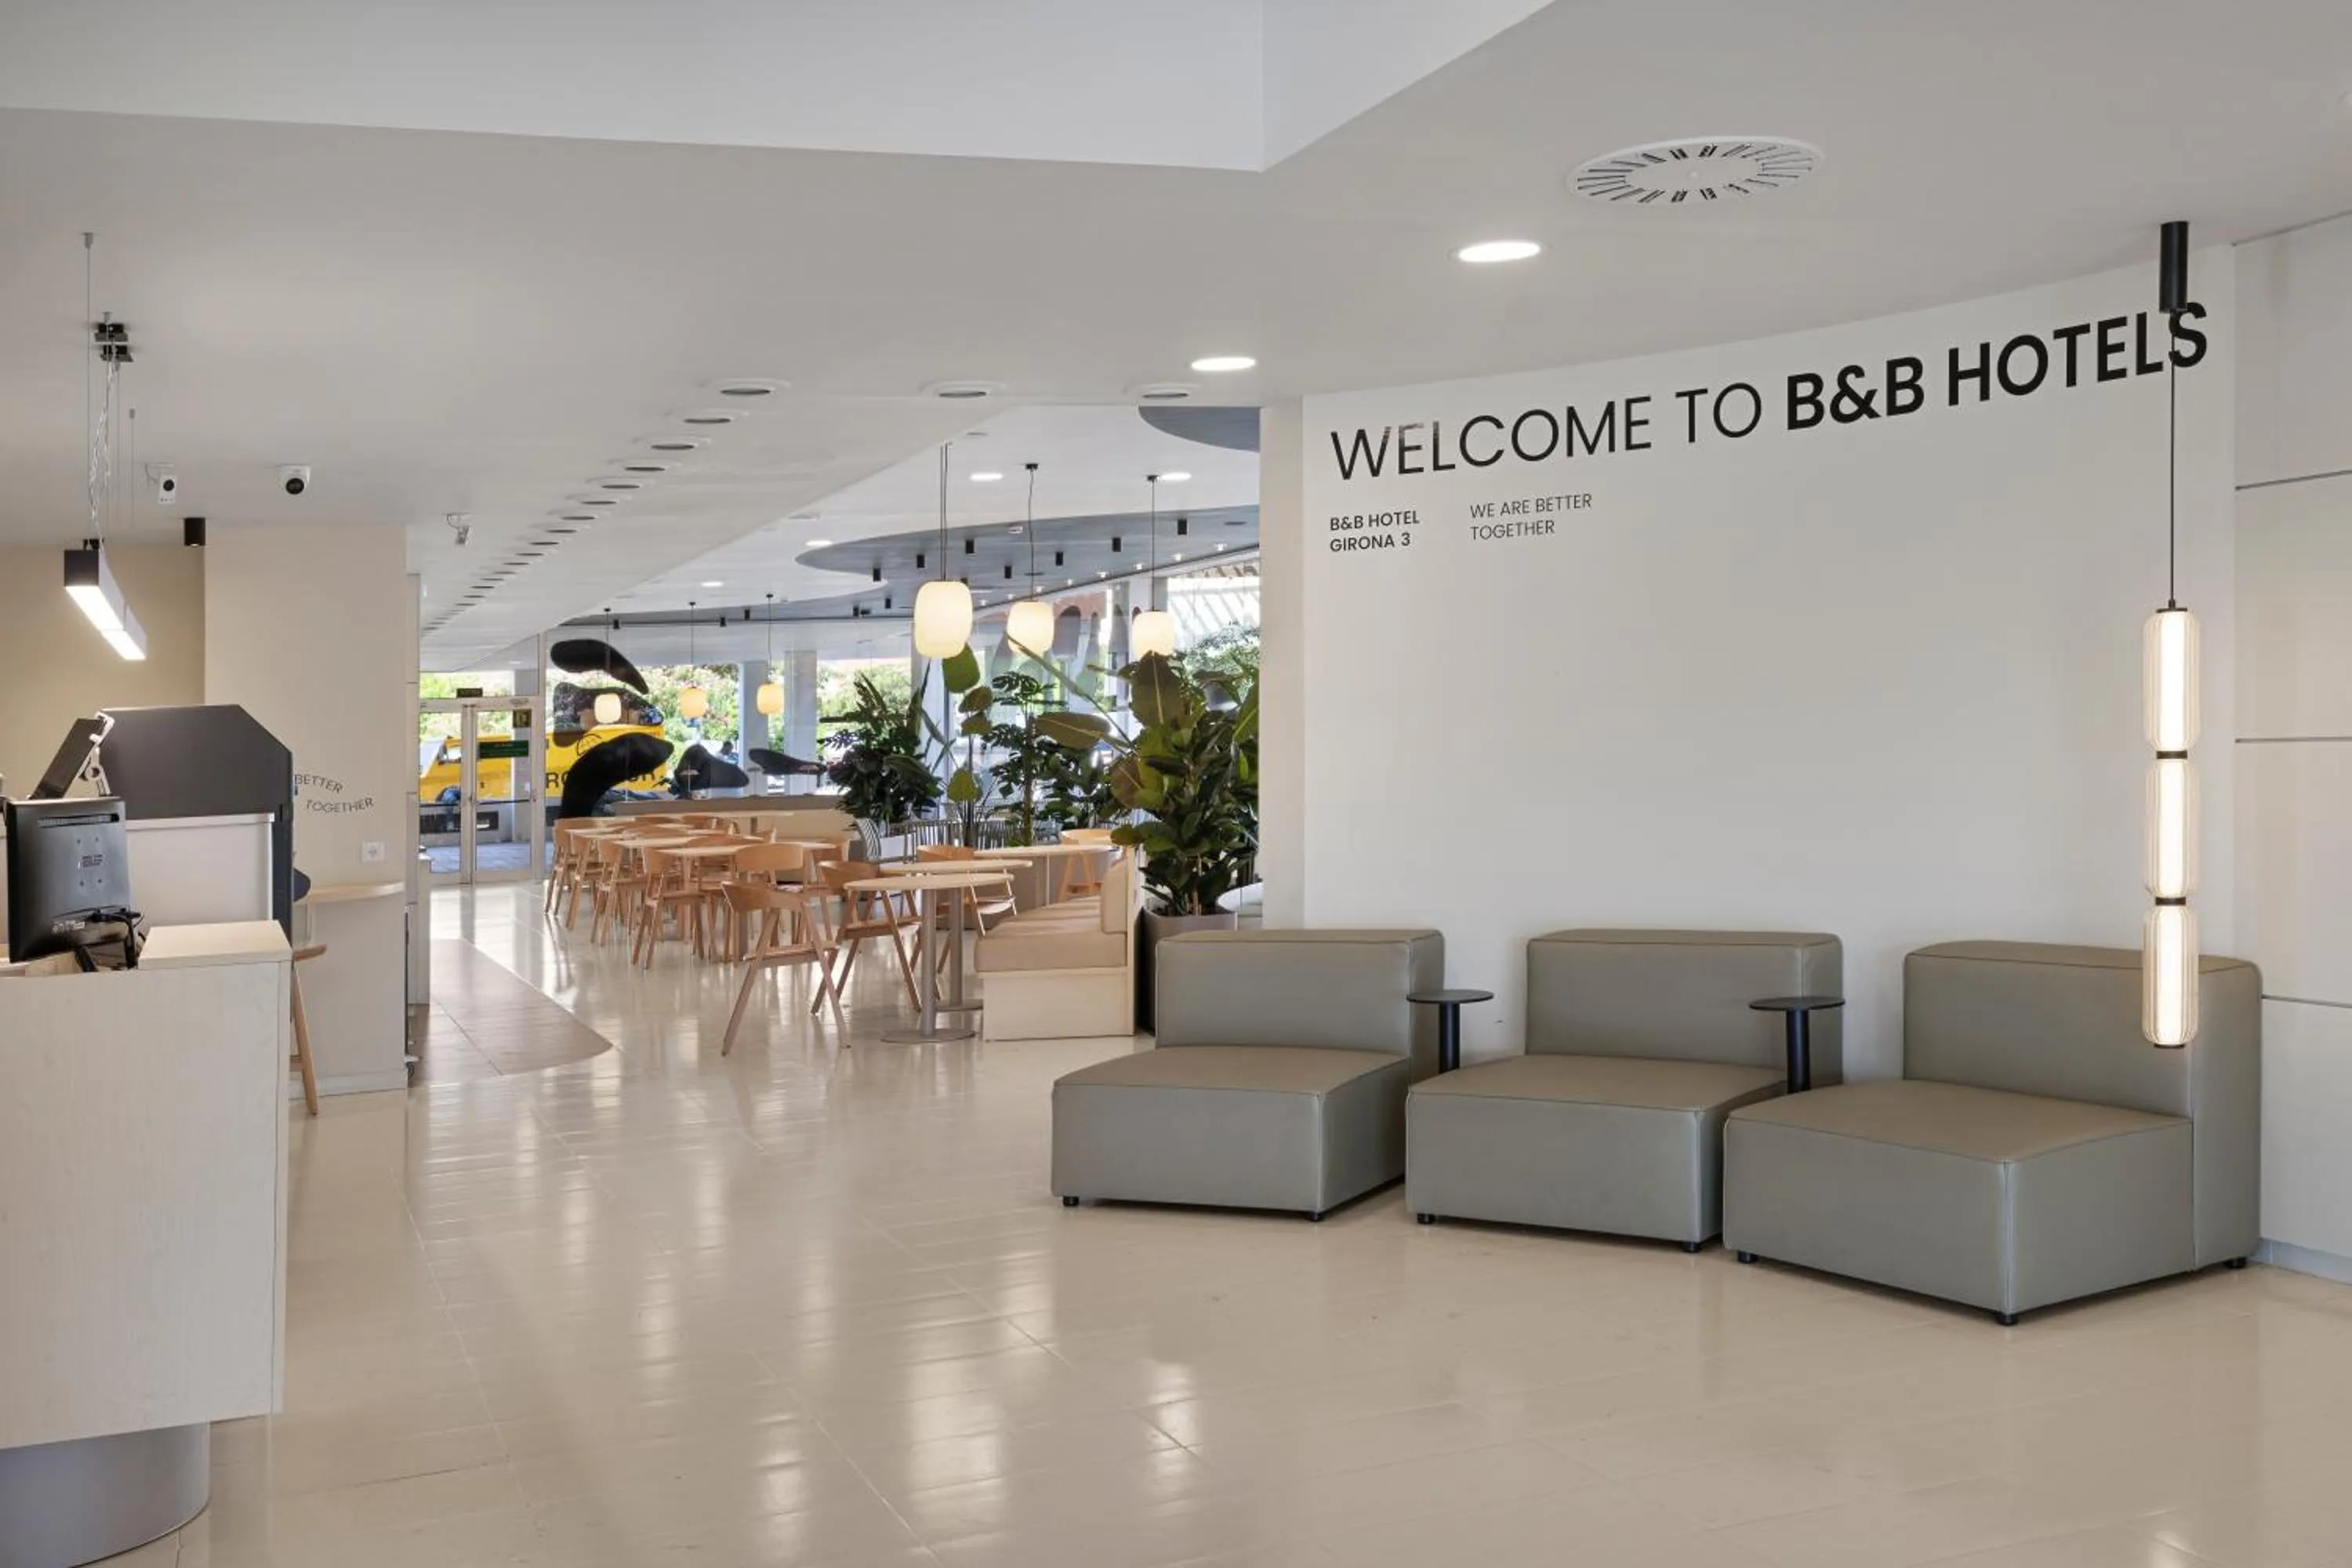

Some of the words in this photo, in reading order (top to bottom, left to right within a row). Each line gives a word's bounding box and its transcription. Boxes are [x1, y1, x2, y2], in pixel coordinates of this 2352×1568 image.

[1330, 395, 1652, 481] WELCOME
[1675, 383, 1762, 444] TO
[1788, 357, 1924, 430] B&B
[1948, 302, 2207, 407] HOTELS
[1470, 503, 1495, 518] WE
[1500, 499, 1530, 516] ARE
[1536, 494, 1592, 513] BETTER
[1330, 515, 1364, 531] B&B
[1369, 510, 1421, 527] HOTEL
[1470, 520, 1555, 540] TOGETHER
[1330, 534, 1396, 552] GIRONA
[1401, 532, 1411, 546] 3
[294, 774, 343, 794] BETTER
[306, 797, 374, 813] TOGETHER
